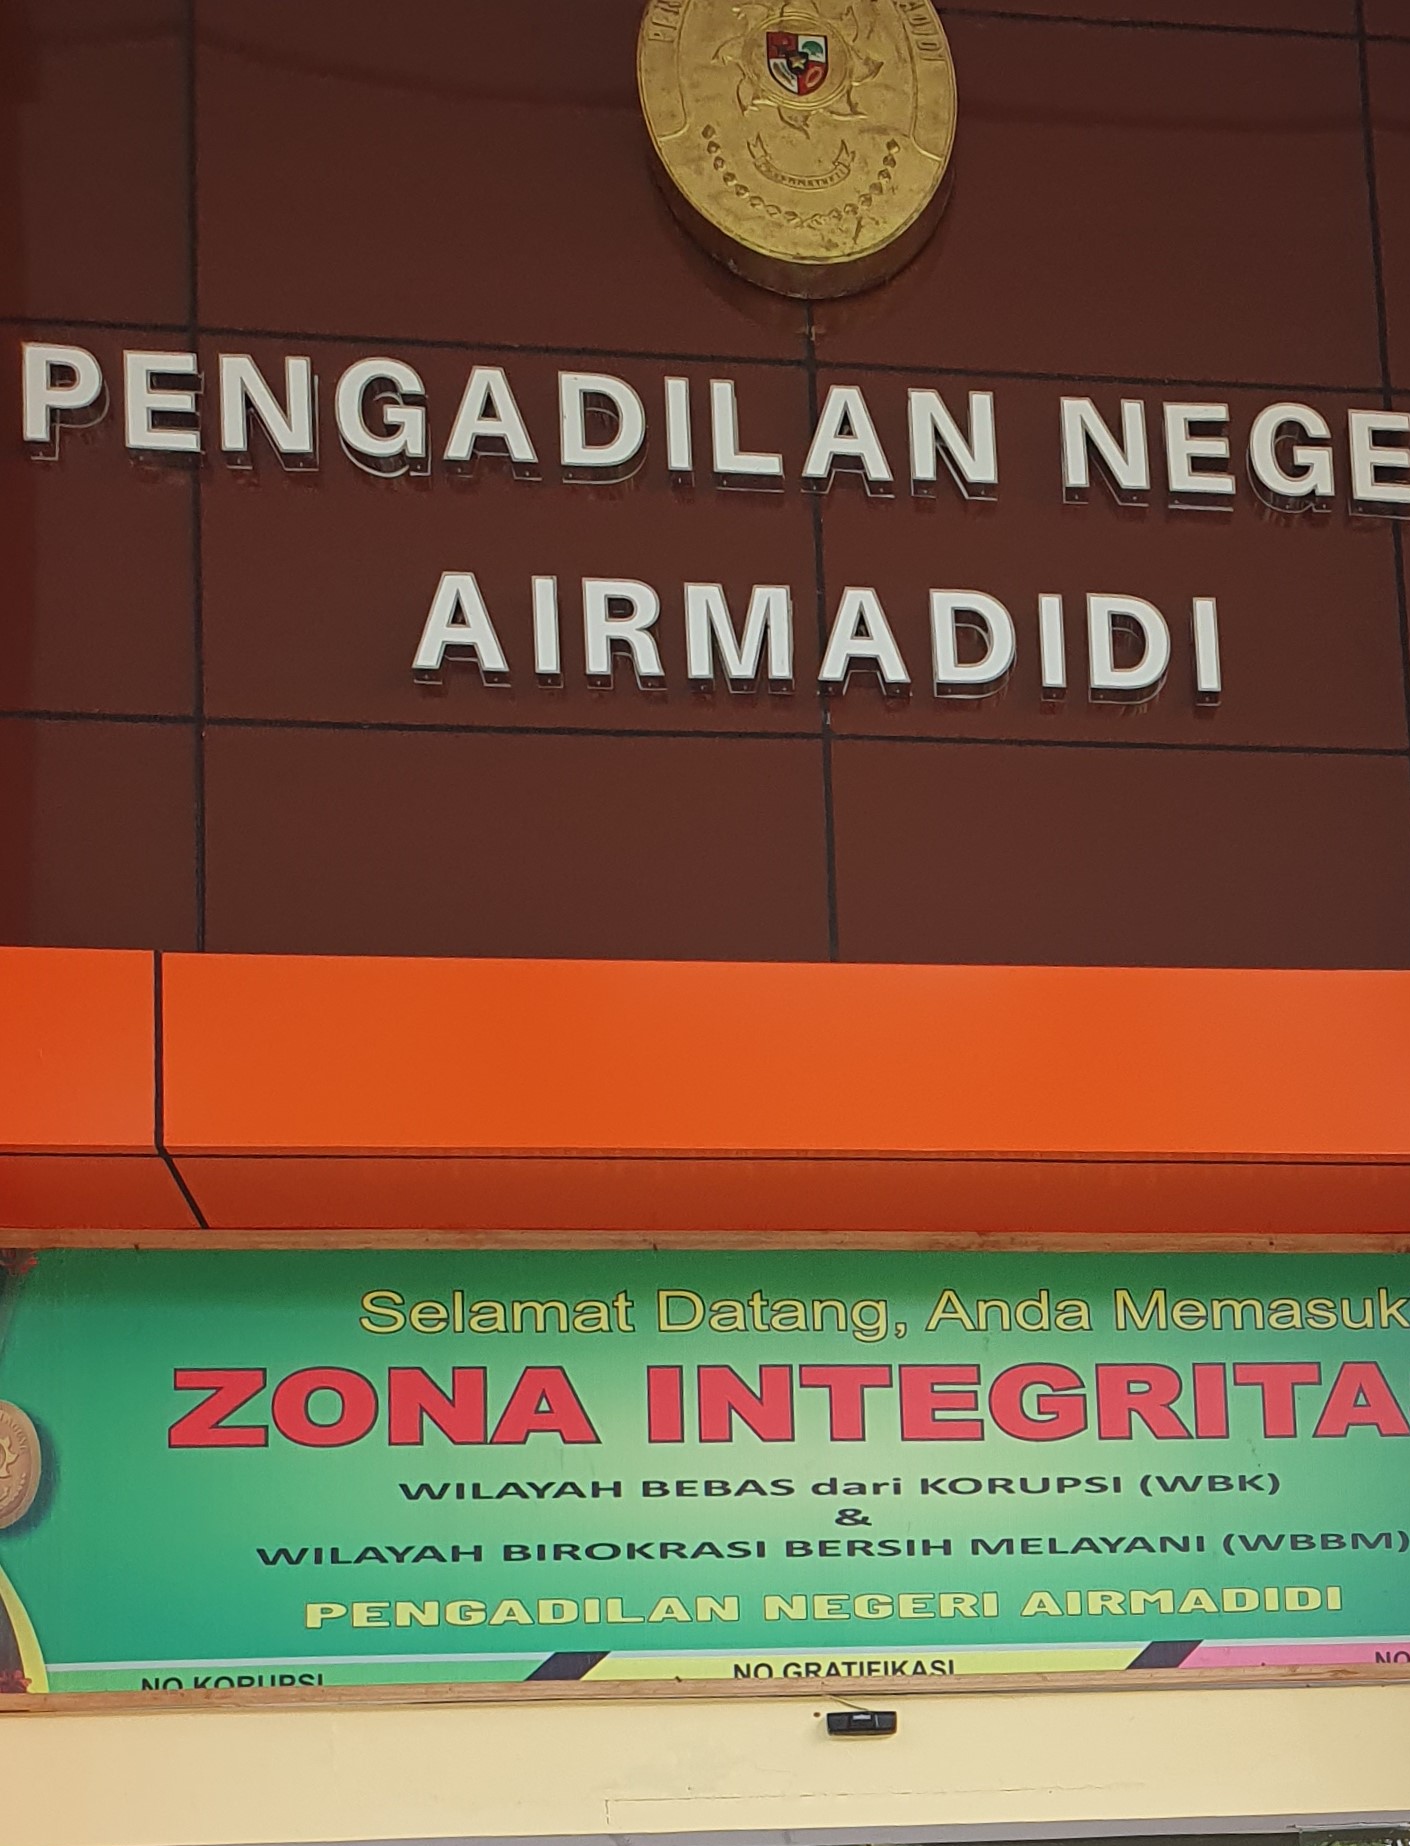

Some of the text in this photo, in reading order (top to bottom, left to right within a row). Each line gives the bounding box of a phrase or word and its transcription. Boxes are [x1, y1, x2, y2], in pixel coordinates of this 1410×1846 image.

[21, 341, 999, 485] PENGADILAN
[412, 571, 1222, 693] AIRMADIDI
[359, 1289, 635, 1334] Selamat
[656, 1289, 908, 1343] Datang,
[925, 1289, 1093, 1332] Anda
[168, 1365, 602, 1449] ZONA
[399, 1473, 1281, 1501] WILAYAH BEBAS dari KORUPSI (WBK)
[834, 1507, 873, 1527] &
[256, 1531, 1410, 1566] WILAYAH BIROKRASI BERSIH MELAYANI (WBBM)
[303, 1585, 1344, 1629] PENGADILAN NEGERI AIRMADIDI
[733, 1659, 955, 1679] NO GRATIFIKASI
